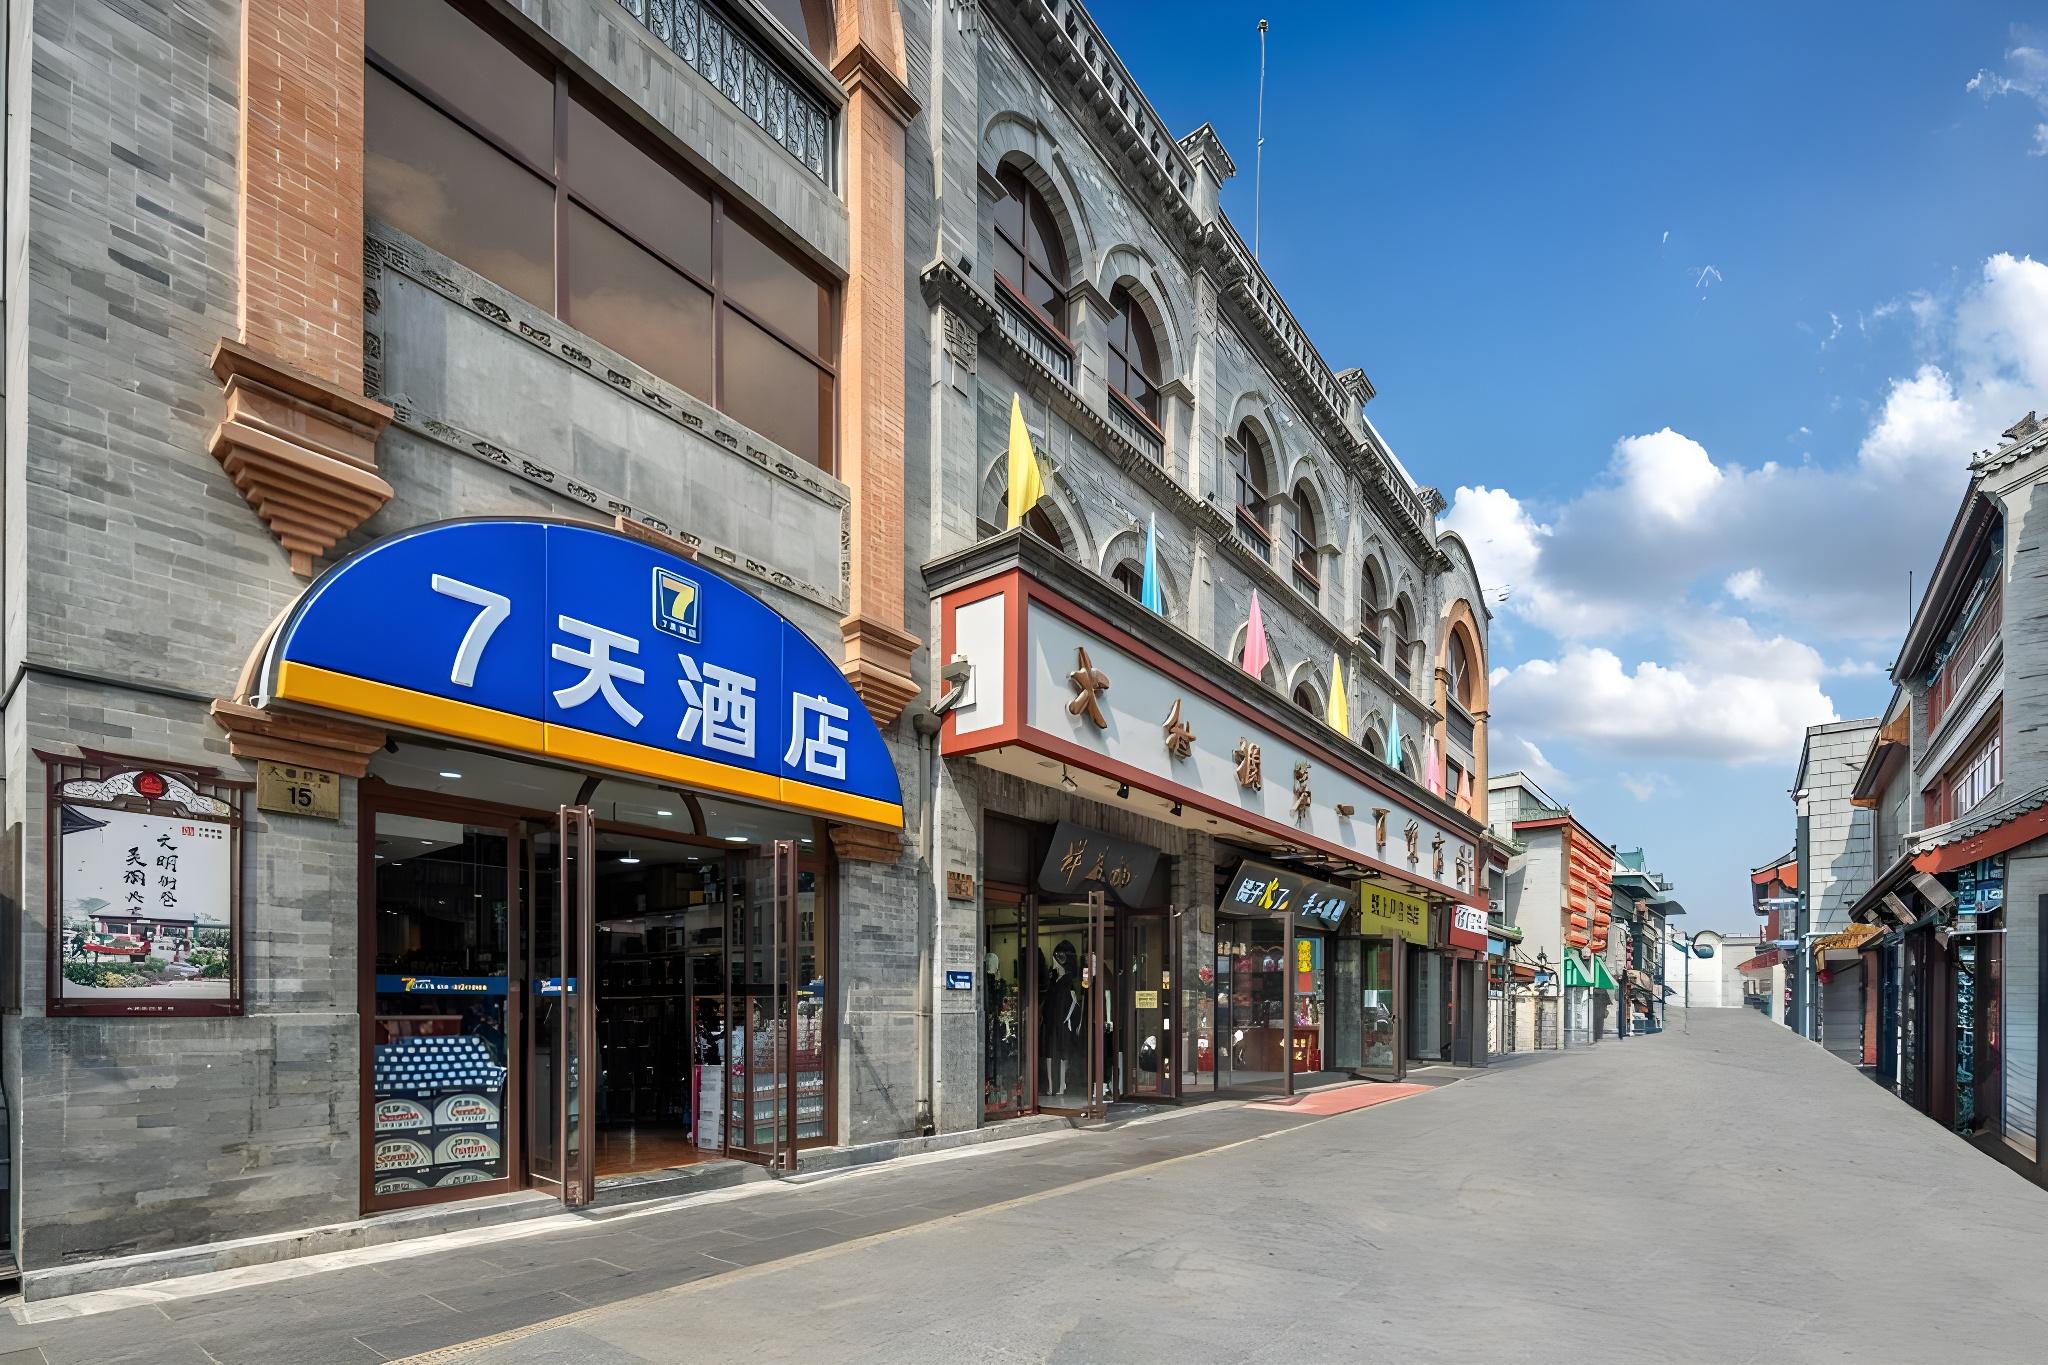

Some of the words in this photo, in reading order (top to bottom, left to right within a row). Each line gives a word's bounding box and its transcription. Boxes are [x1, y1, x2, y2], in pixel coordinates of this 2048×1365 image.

[662, 575, 695, 621] 7
[431, 573, 849, 781] 7天酒店
[287, 786, 312, 807] 15
